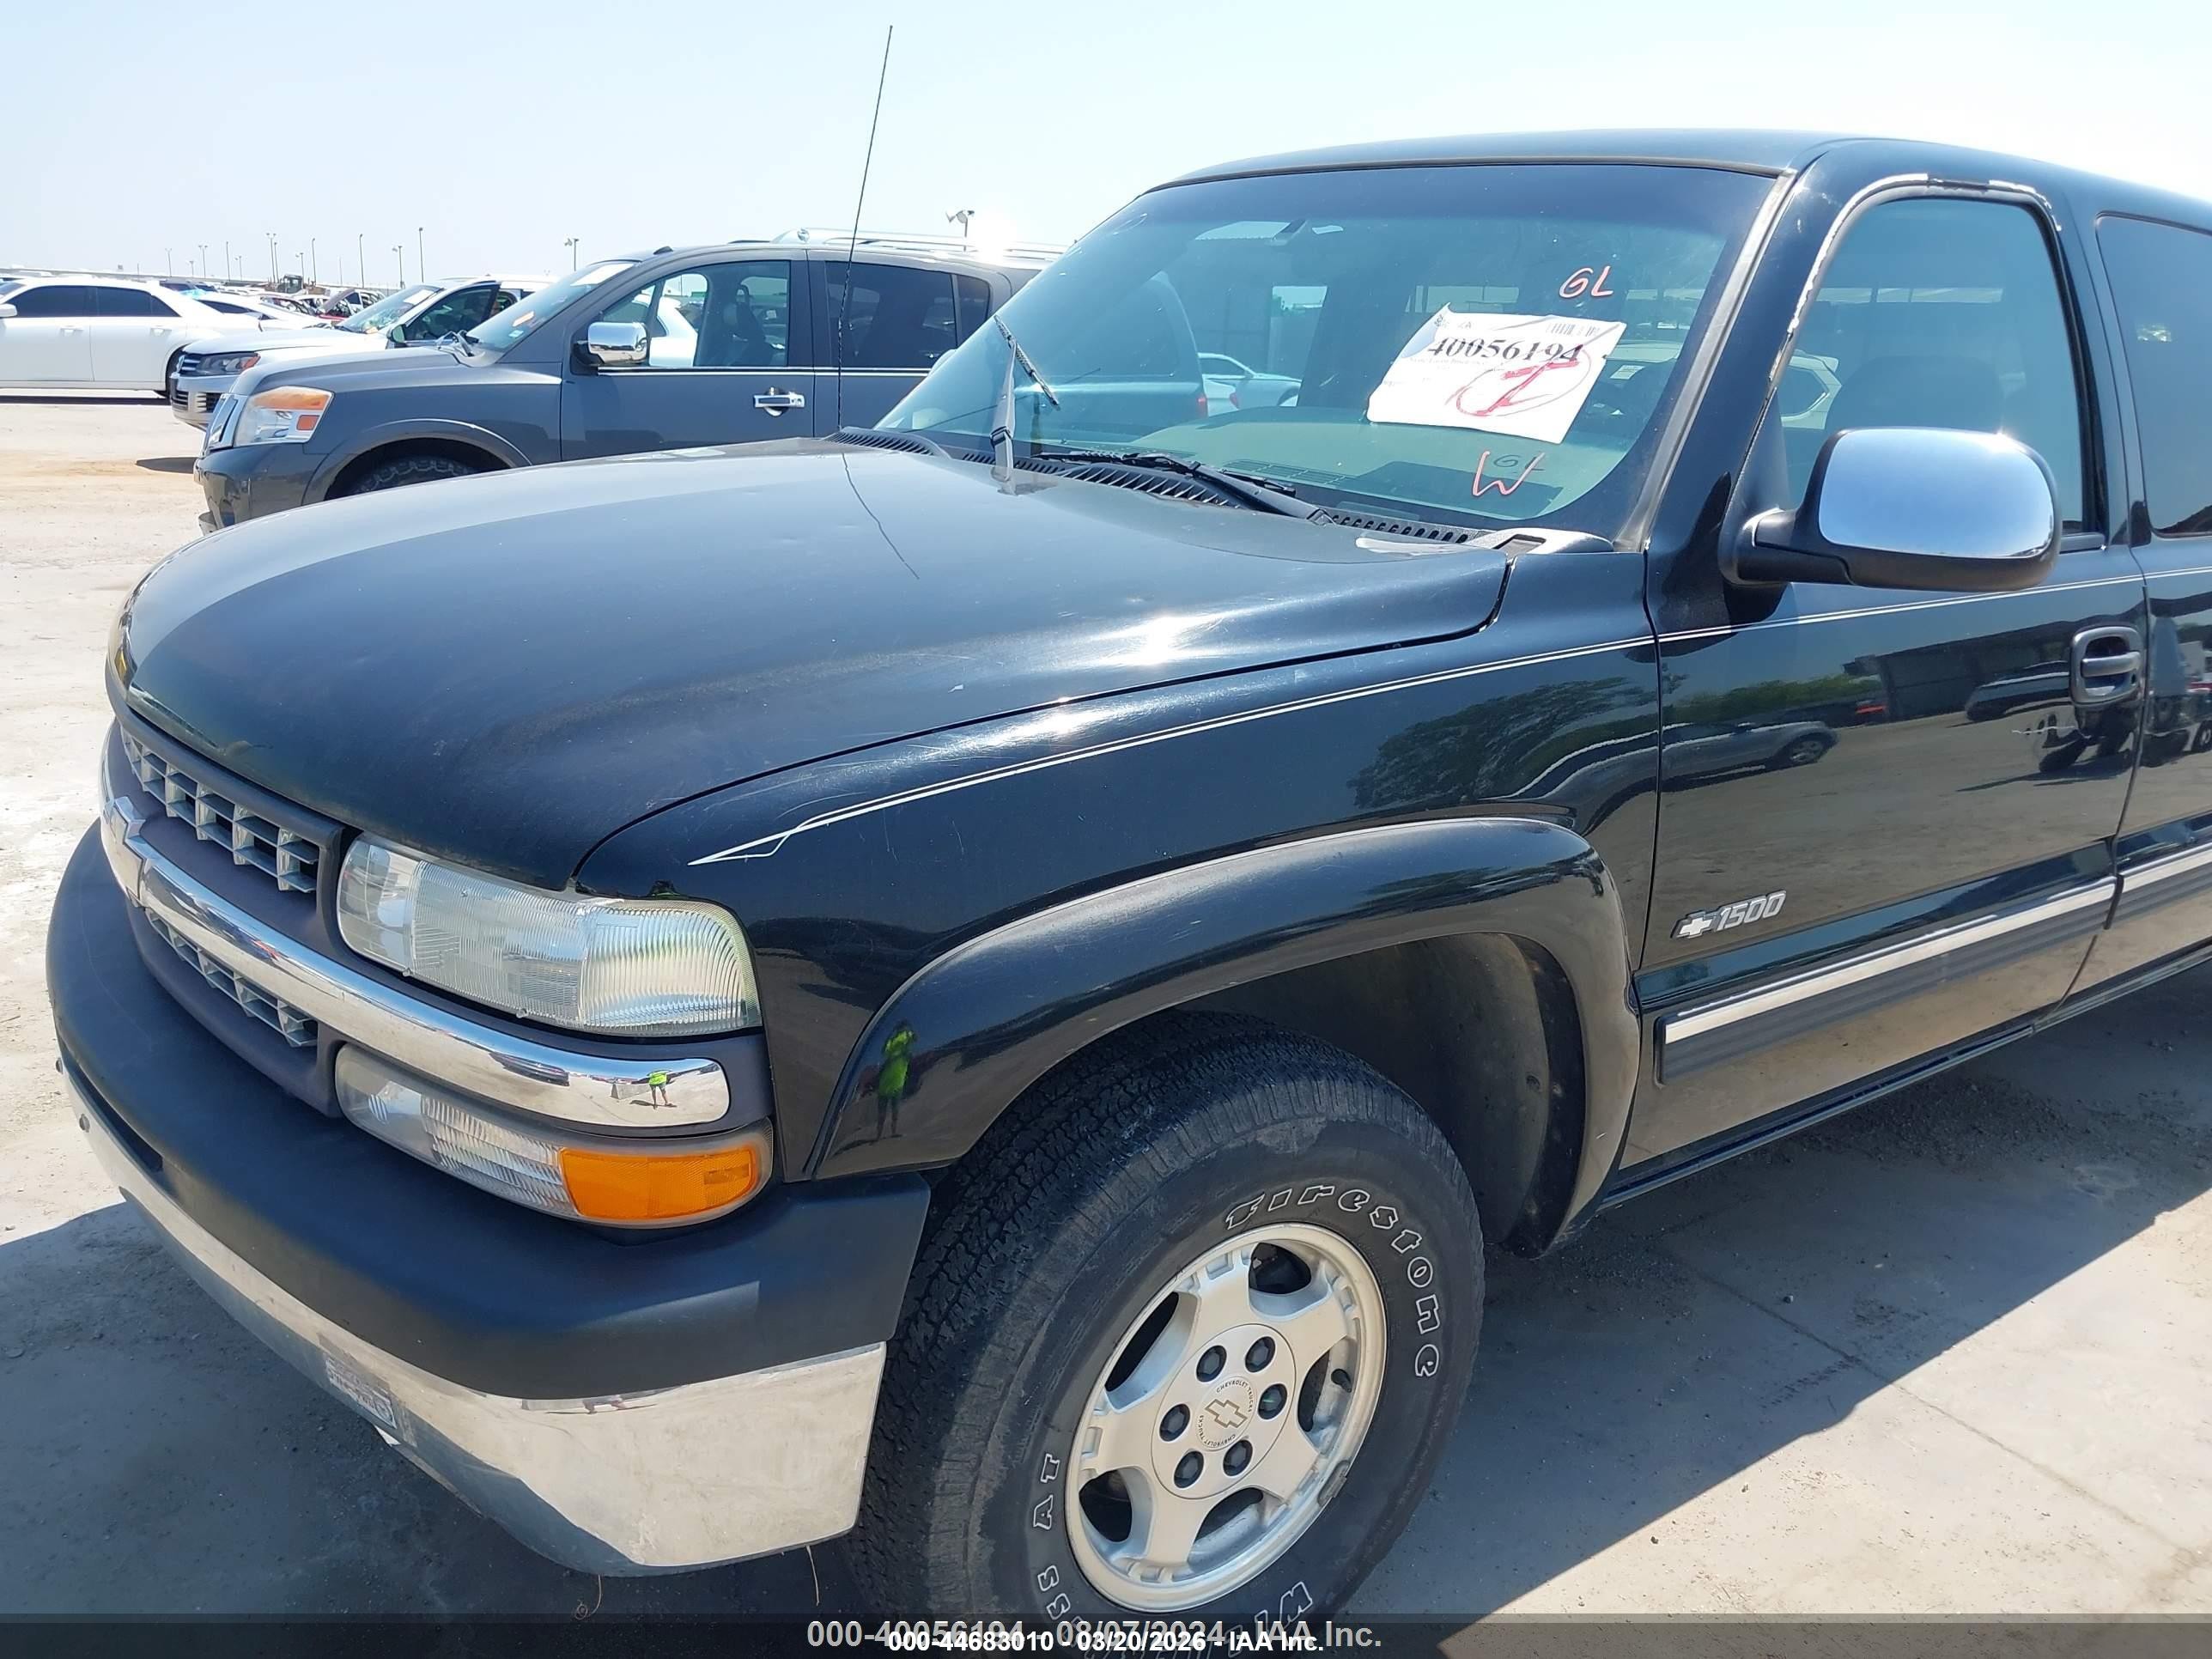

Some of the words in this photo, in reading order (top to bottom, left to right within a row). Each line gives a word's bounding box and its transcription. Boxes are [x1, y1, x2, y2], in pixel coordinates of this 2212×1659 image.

[1559, 265, 1613, 298] GL
[1428, 337, 1583, 364] 40056194
[1716, 890, 1787, 933] 1500
[1216, 1380, 1249, 1393] CHEVROLET
[1033, 1453, 1060, 1530] AT
